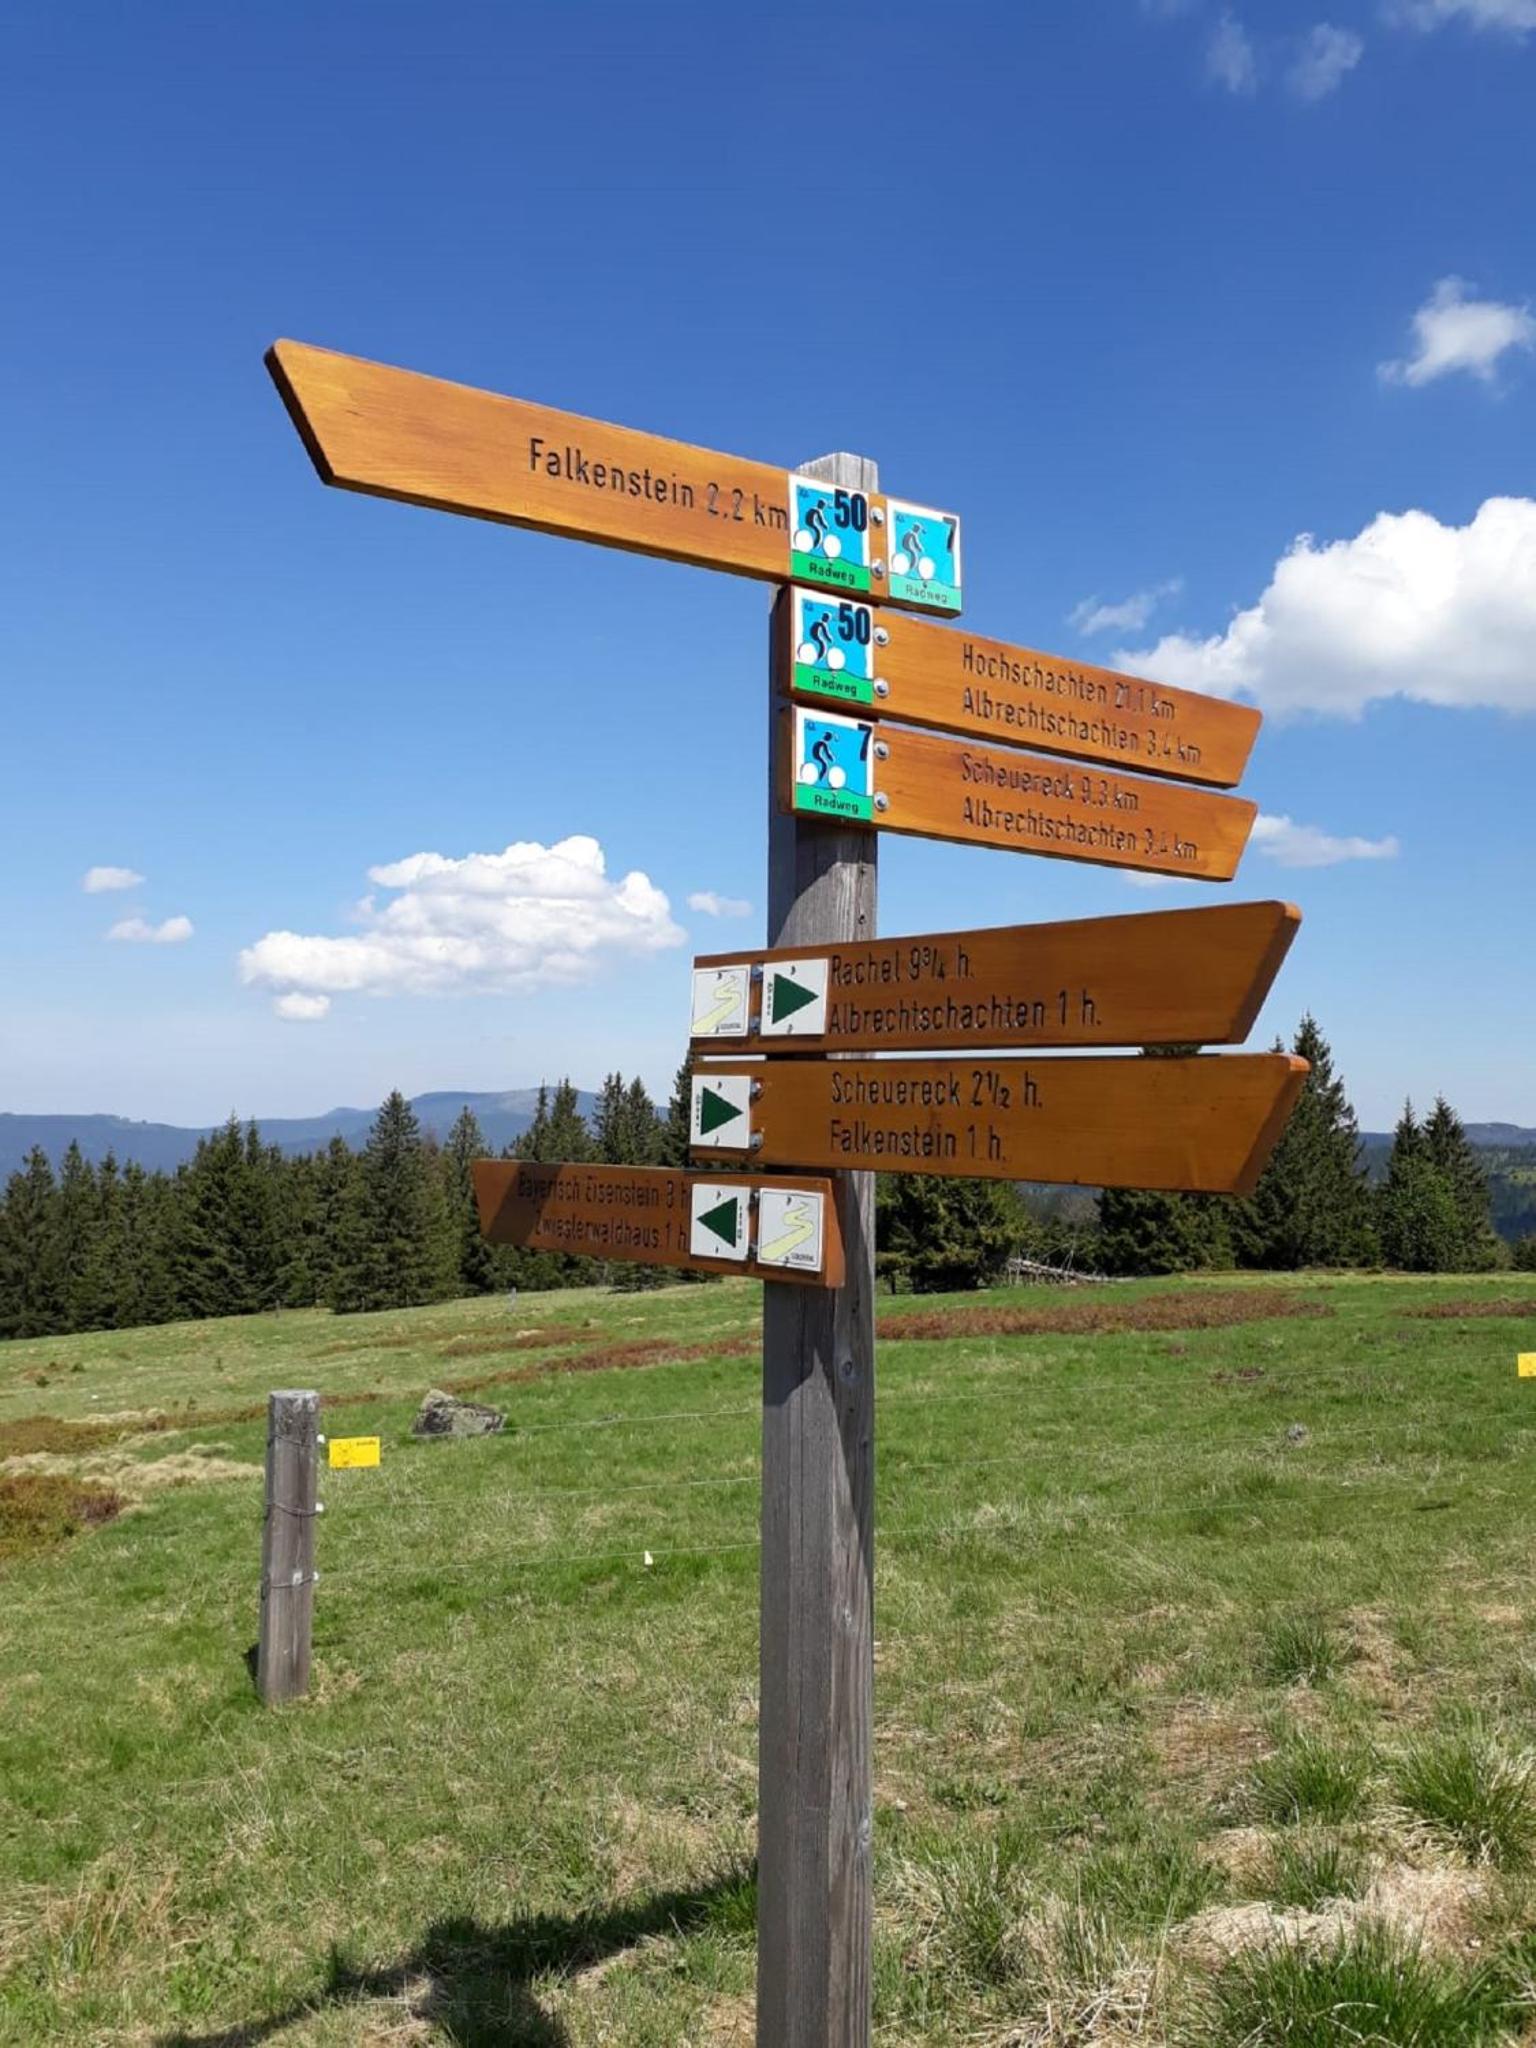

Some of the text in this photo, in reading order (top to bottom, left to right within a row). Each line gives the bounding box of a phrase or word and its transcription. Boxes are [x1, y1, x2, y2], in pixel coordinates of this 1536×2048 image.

[529, 438, 789, 530] Falkenstein 2.2 km
[834, 489, 868, 532] 50
[943, 516, 958, 553] 7
[809, 562, 856, 585] Radweg
[906, 584, 948, 604] Radweg
[838, 602, 871, 645] 50
[813, 676, 858, 696] Radweg
[962, 643, 1107, 704] Hochschachten
[1151, 691, 1176, 721] km
[858, 723, 872, 761] 7
[962, 687, 1202, 765] Albrechtschachten 3.4 km
[962, 752, 1139, 811] Scheuereck 9.3 km
[814, 795, 859, 814] Radweg
[962, 796, 1198, 860] Albrechtschachten 3.4 km
[830, 950, 901, 986] Rachel
[828, 988, 1102, 1036] Albrechtschachten 1 h.
[831, 1071, 961, 1107] Scheuereck
[1024, 1071, 1043, 1109] h.
[831, 1119, 957, 1158] Falkenstein
[967, 1123, 976, 1159] 1
[585, 1175, 660, 1207] Eisenstein
